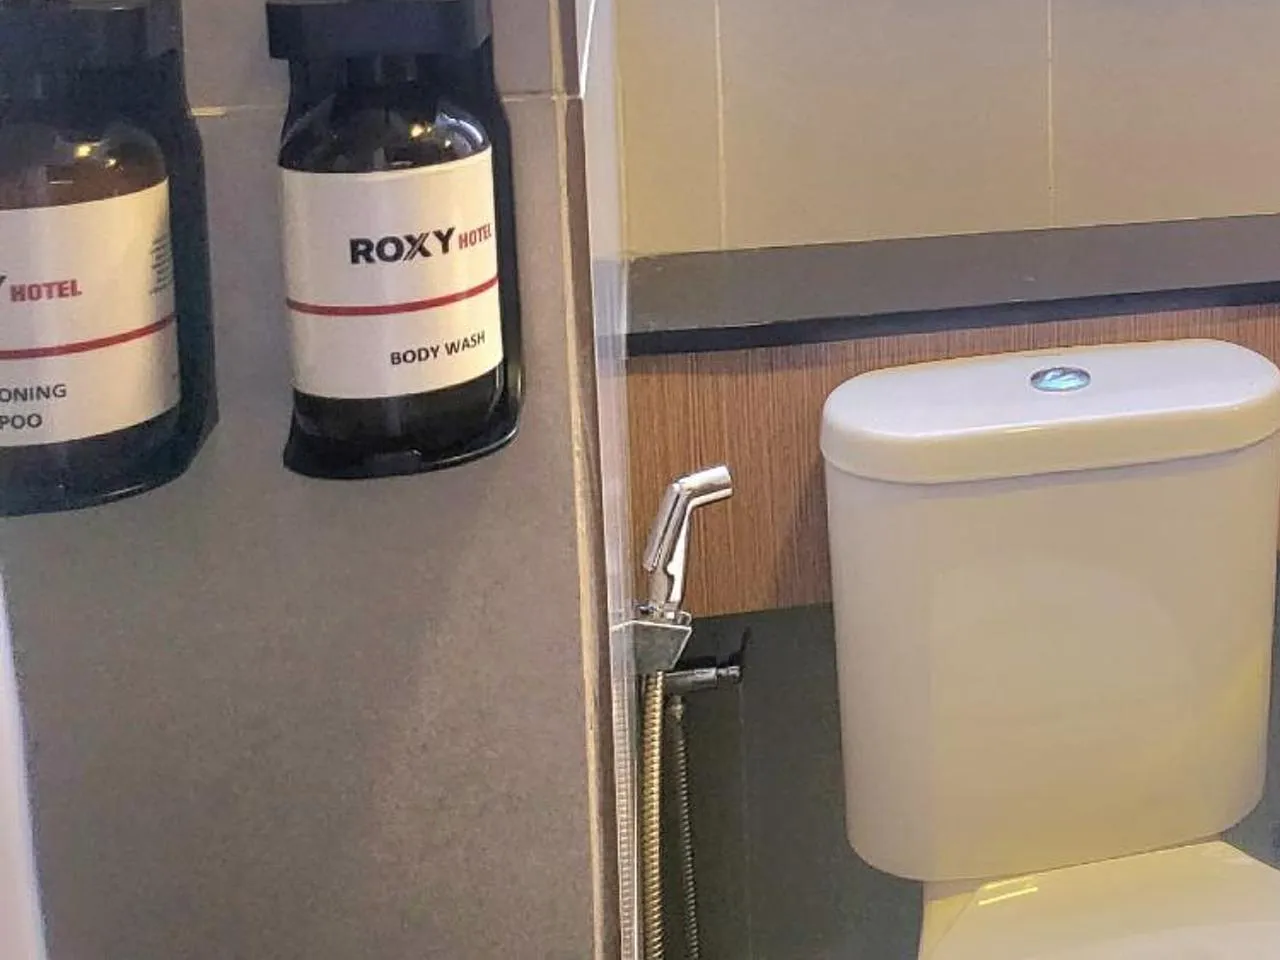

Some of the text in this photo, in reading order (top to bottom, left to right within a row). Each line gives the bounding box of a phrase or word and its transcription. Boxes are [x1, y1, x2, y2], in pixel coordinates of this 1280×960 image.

[350, 223, 492, 265] ROXY HOTEL
[10, 278, 83, 302] HOTEL
[390, 331, 486, 366] BODY WASH
[0, 383, 67, 402] ONING
[0, 413, 43, 430] POO
